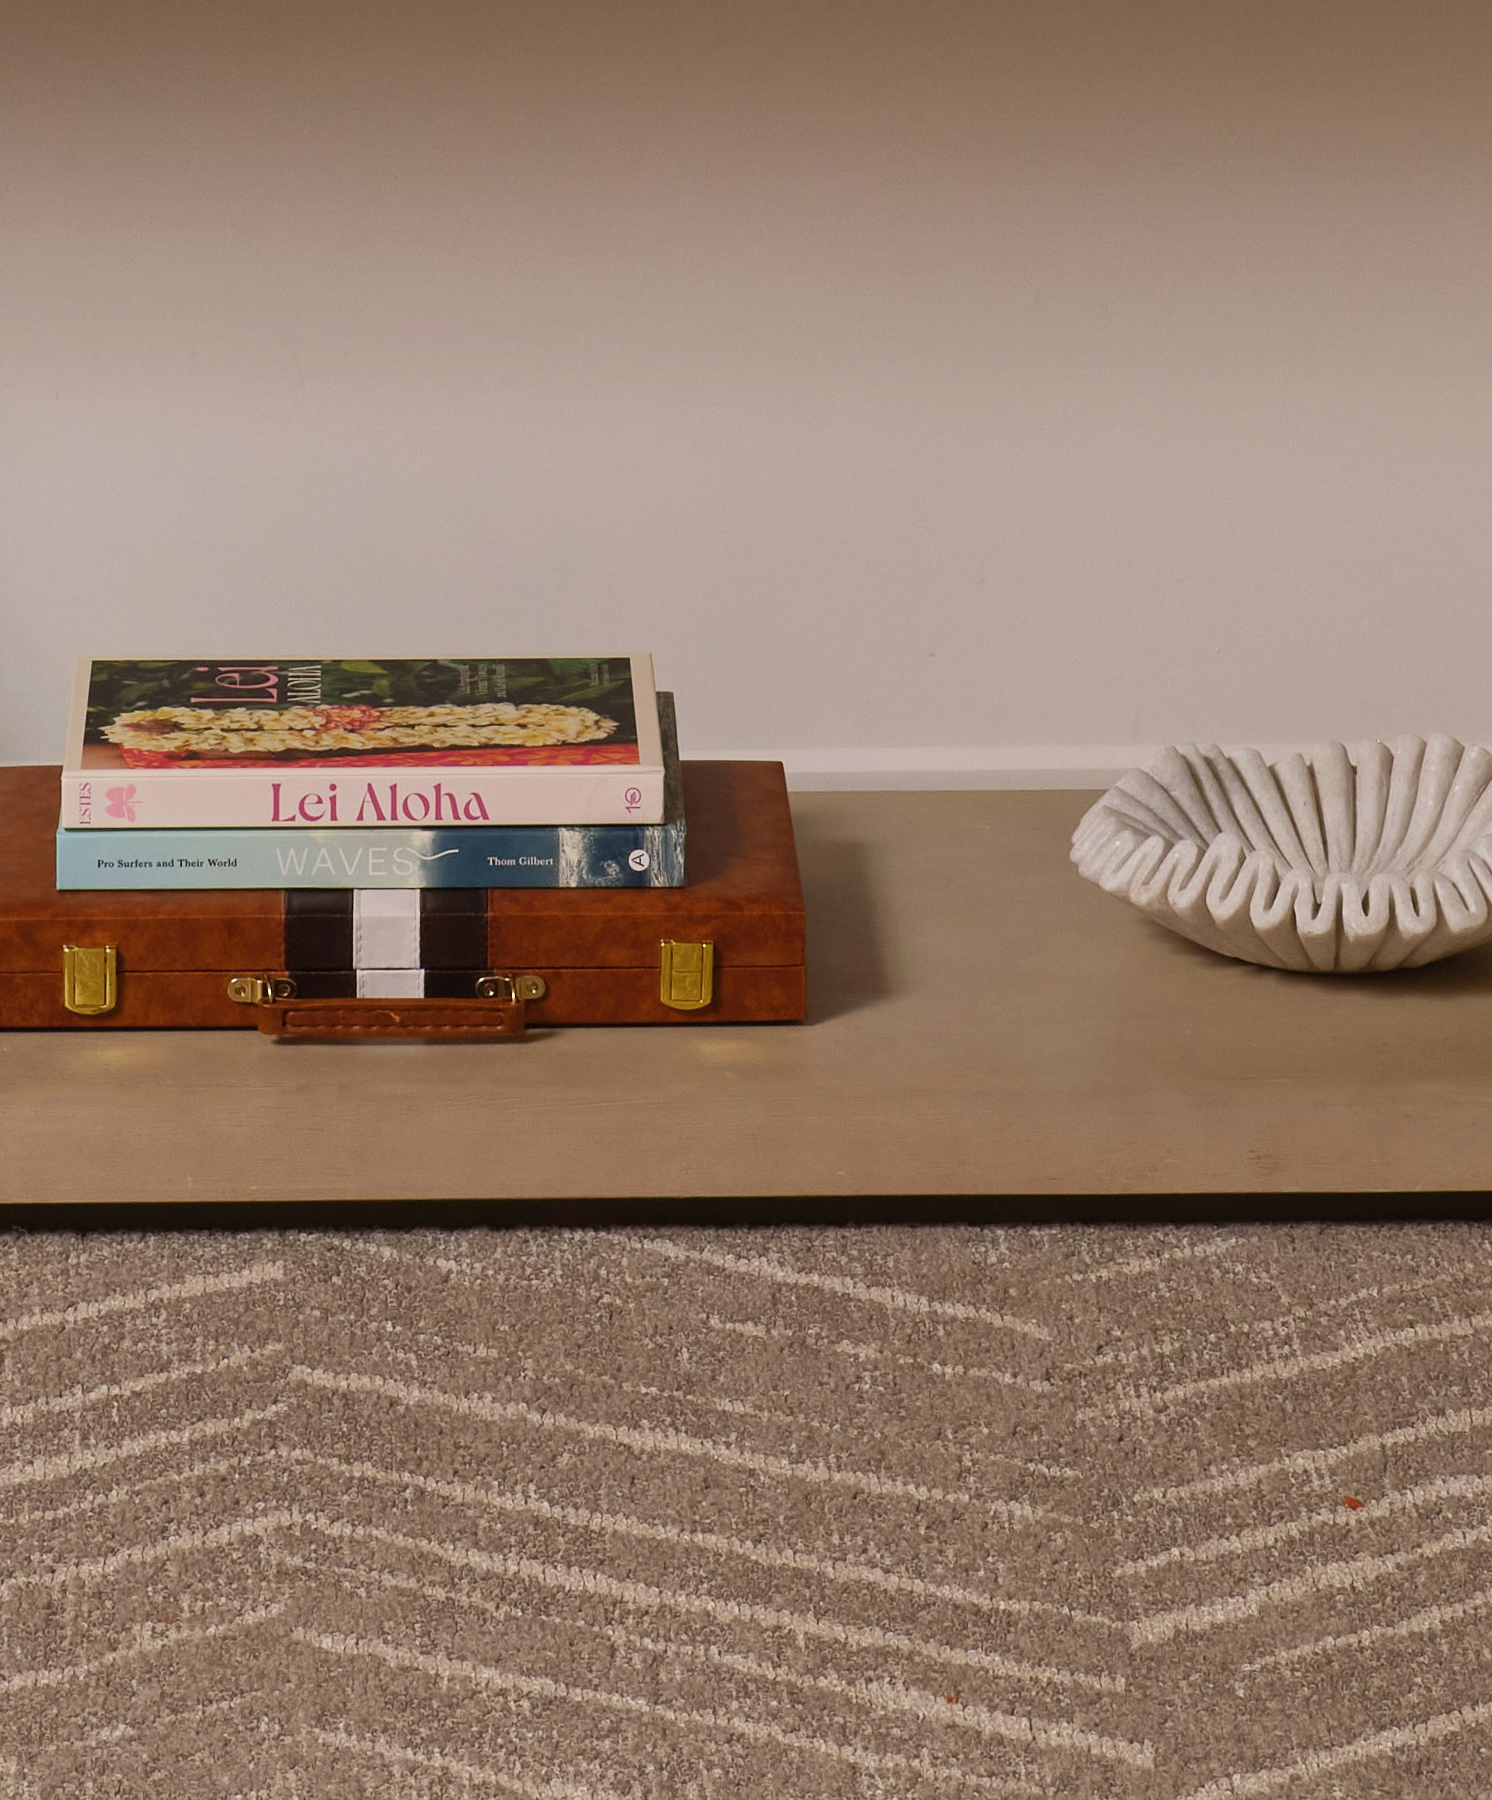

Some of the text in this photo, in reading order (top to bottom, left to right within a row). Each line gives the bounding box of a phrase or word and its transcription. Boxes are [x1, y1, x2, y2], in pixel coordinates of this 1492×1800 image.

[190, 665, 279, 703] Lei
[287, 665, 322, 704] ALOHA
[78, 782, 92, 825] ESTES
[271, 782, 490, 822] Lei Aloha
[97, 858, 238, 869] Pro Surfers and Their World
[275, 847, 414, 877] WAVES
[487, 856, 554, 867] Thom Gilbert
